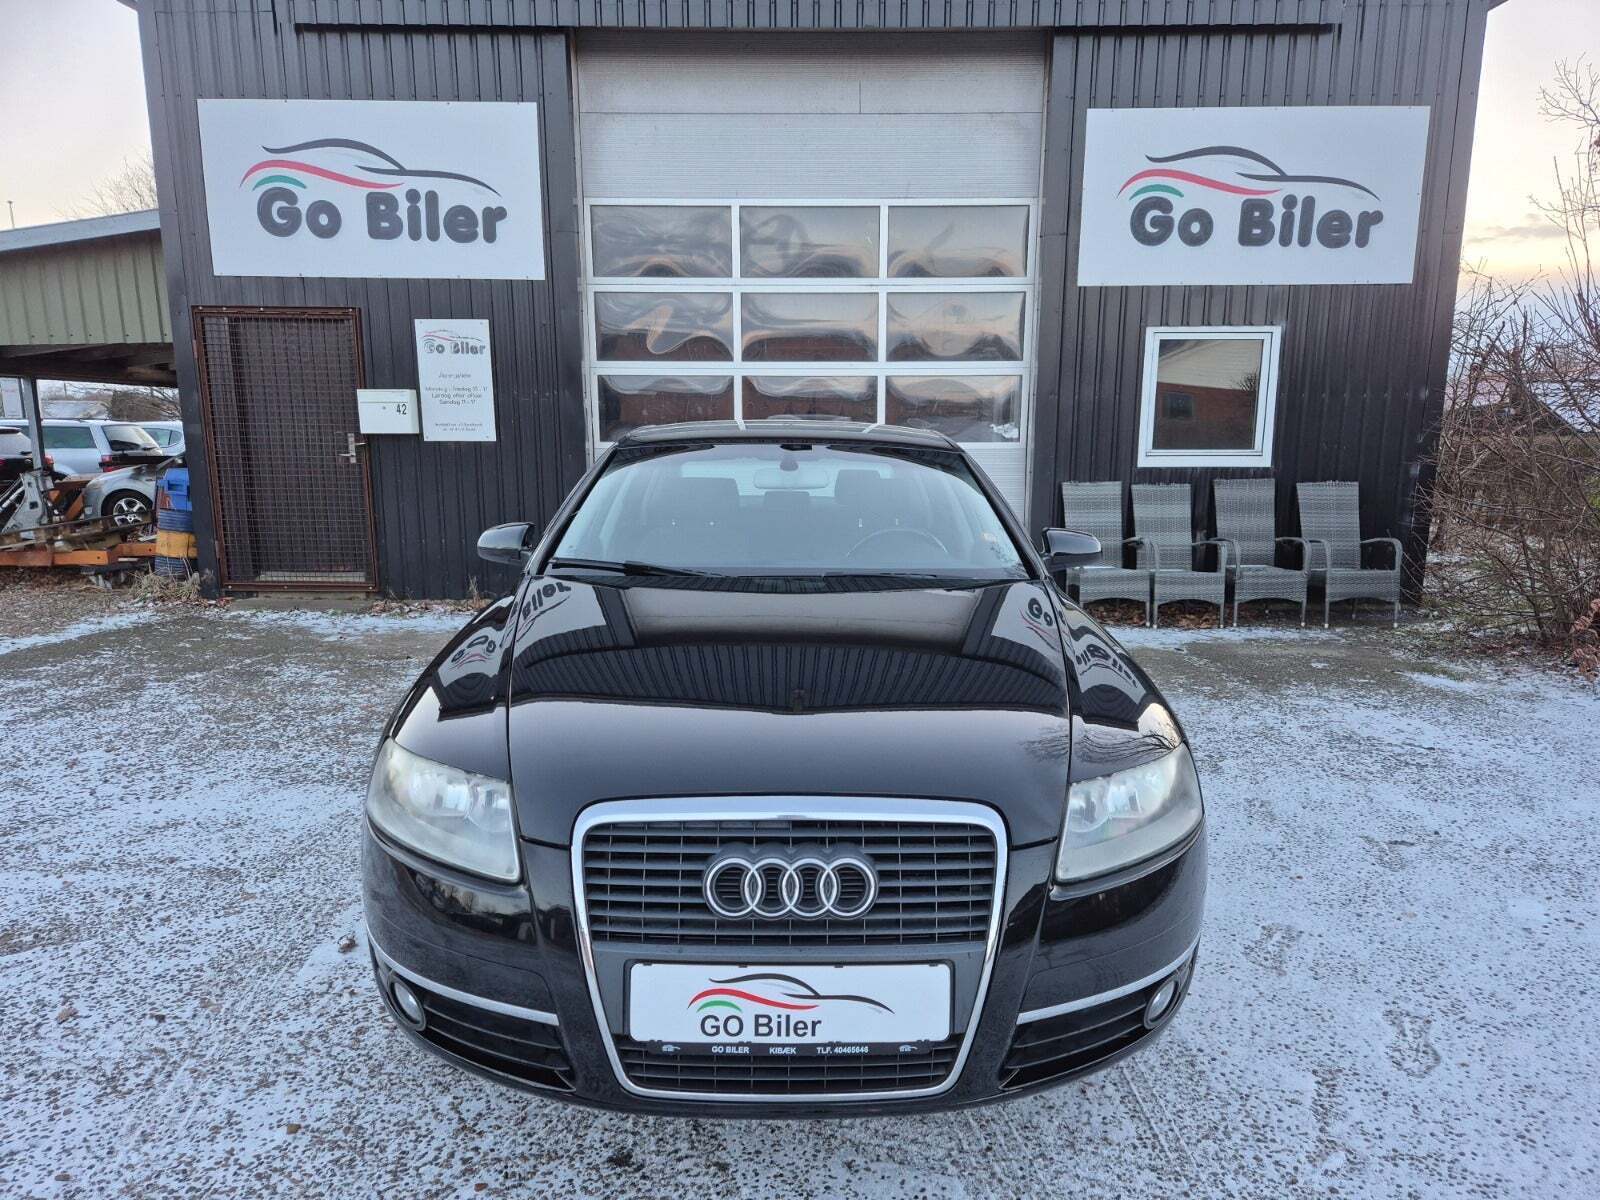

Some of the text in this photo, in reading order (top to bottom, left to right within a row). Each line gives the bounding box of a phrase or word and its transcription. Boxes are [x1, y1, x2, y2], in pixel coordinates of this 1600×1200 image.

[257, 186, 508, 244] Go Biler
[1130, 194, 1384, 249] Go Biler
[396, 403, 407, 415] 42
[700, 1014, 822, 1038] GO Biler
[711, 1045, 724, 1053] GO
[725, 1045, 750, 1054] BILER
[769, 1047, 797, 1055] KIBÆK
[816, 1046, 833, 1054] TLF.
